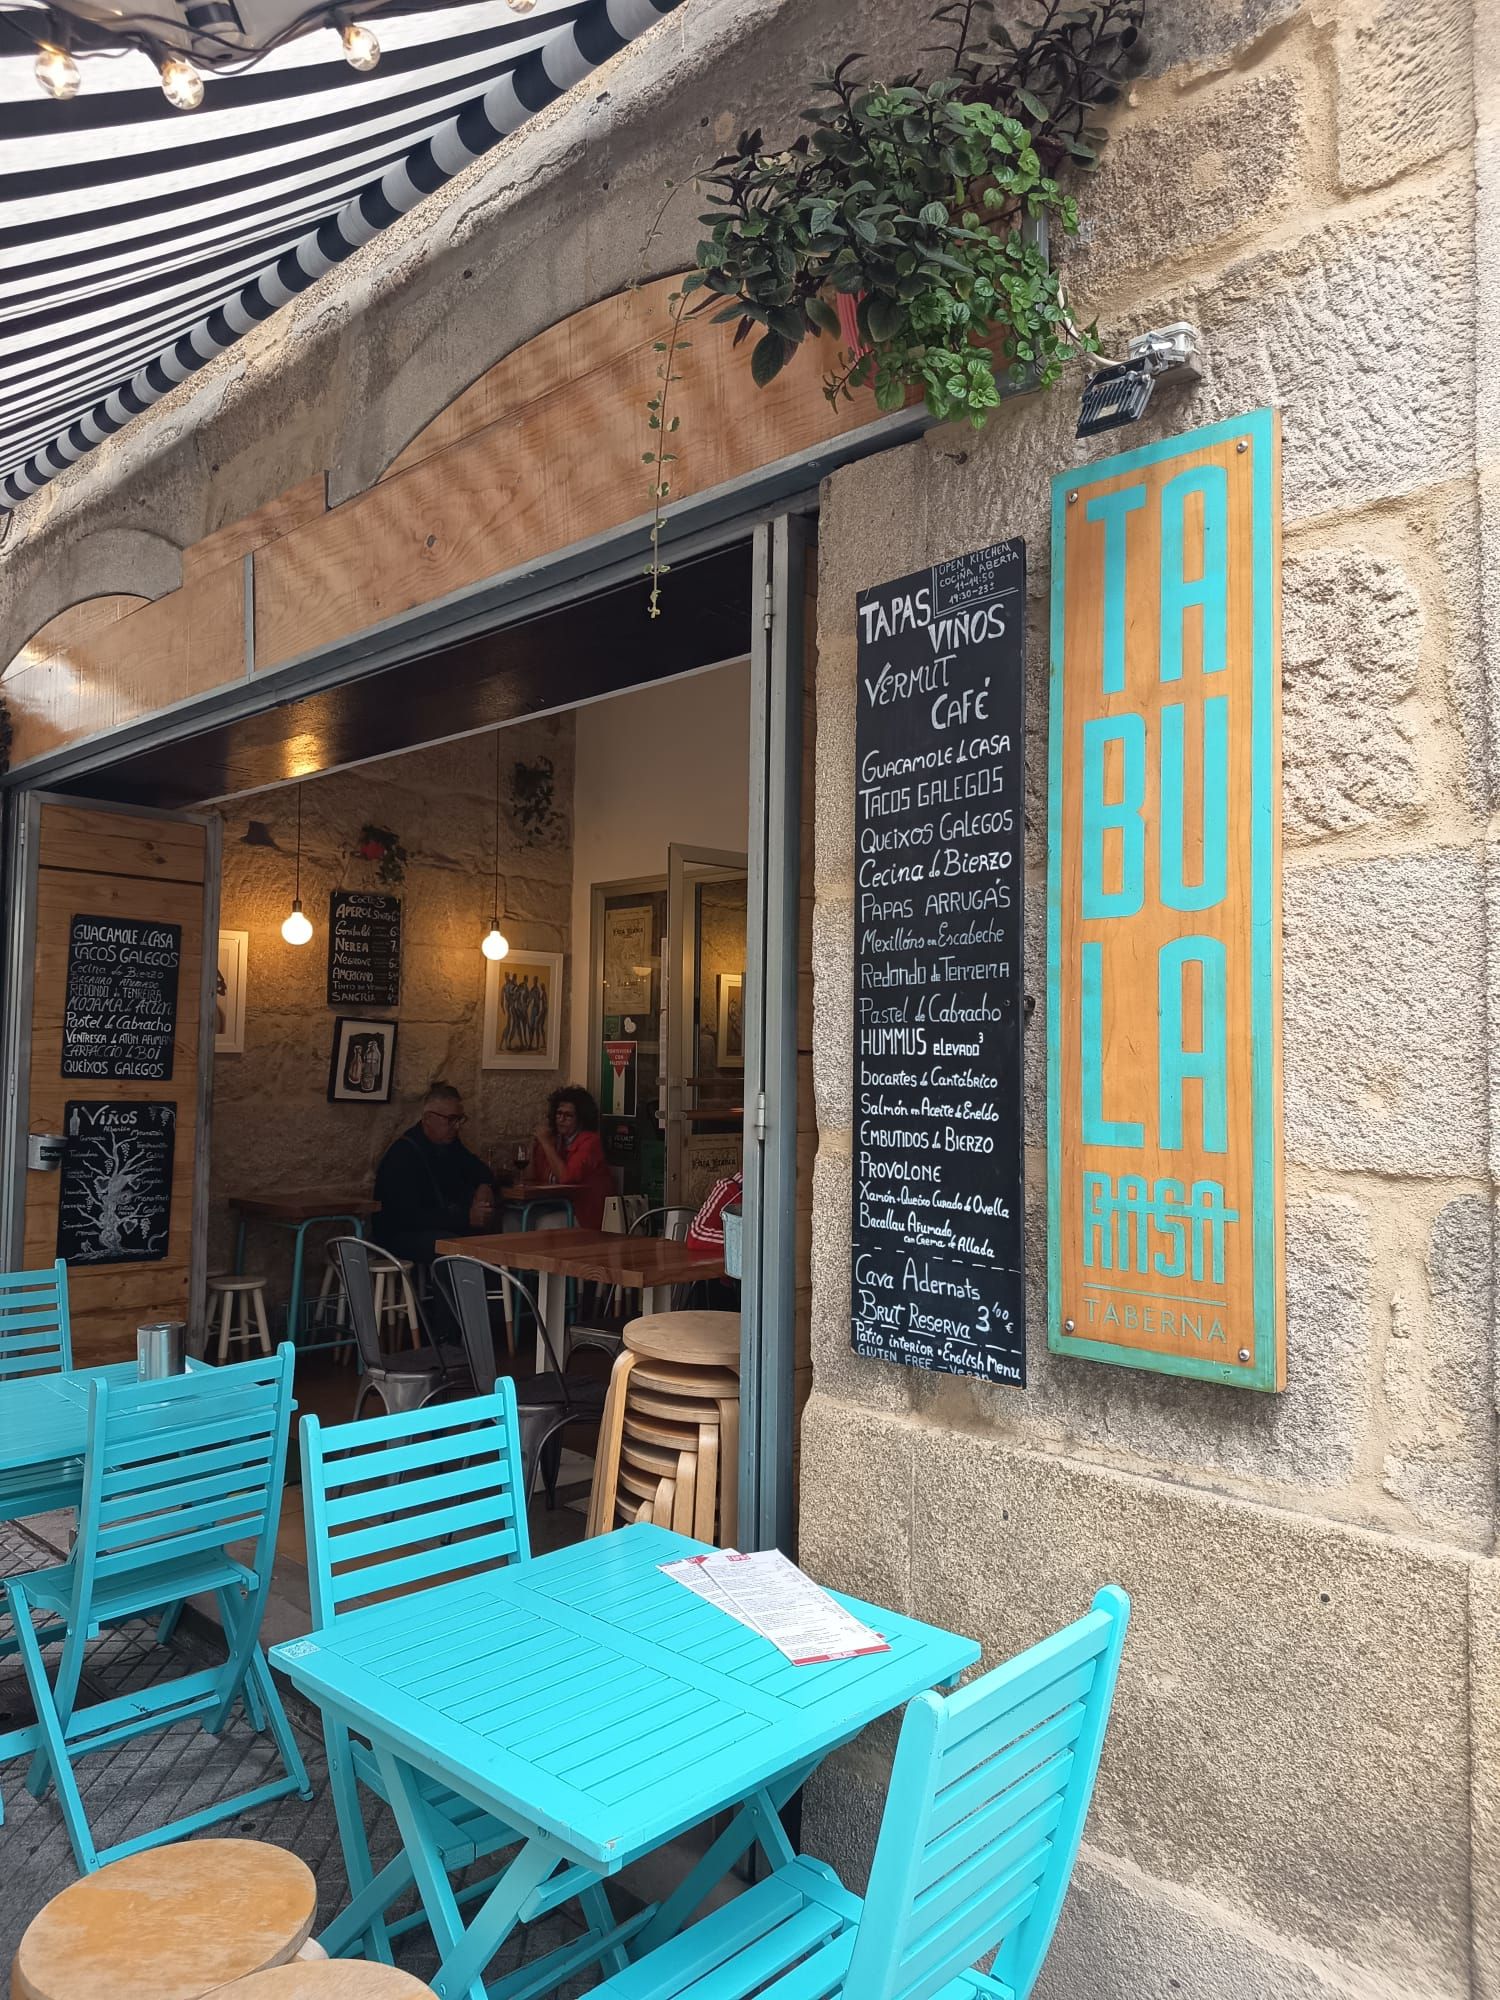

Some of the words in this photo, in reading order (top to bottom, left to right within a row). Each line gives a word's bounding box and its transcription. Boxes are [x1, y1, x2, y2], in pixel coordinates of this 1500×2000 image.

[938, 558, 964, 576] OPEN
[970, 543, 1012, 564] KITCHEN
[940, 566, 974, 588] COCIÑA
[978, 552, 1020, 574] ABERTA
[859, 588, 931, 644] TAPAS
[927, 603, 1006, 654] VIÑOS
[864, 654, 957, 708] VERMUT
[931, 676, 991, 730] CAFÉ
[969, 735, 1010, 759] CASA
[859, 786, 911, 820] TACOS
[918, 766, 1003, 807] GALEGOS
[859, 858, 925, 888] Cecina
[861, 893, 913, 923] PAPAS
[73, 924, 138, 945] GUACAMOLE
[148, 930, 173, 949] CASA
[860, 927, 925, 955] Mexillóns
[938, 917, 1005, 948] Escabeche
[72, 942, 117, 962] TACOS
[120, 947, 179, 967] GALEGOS
[861, 957, 926, 989] Redondo
[70, 984, 109, 997] REDONDO
[66, 1011, 102, 1029] Pastel
[116, 1015, 172, 1032] Cabracho
[859, 996, 909, 1024] Pastel
[915, 995, 925, 1022] de
[929, 992, 1001, 1023] Cabracho
[66, 1028, 107, 1044] VENTRESCA
[861, 1028, 927, 1055] HUMMUS
[115, 1062, 164, 1077] GALEGOS
[860, 1093, 908, 1116] Salmón
[921, 1097, 953, 1118] Aceite
[962, 1101, 999, 1122] Eneldo
[860, 1152, 942, 1182] PROVOLONE
[859, 1180, 896, 1204] Xamón
[900, 1186, 930, 1207] Queixo
[973, 1195, 1010, 1218] Ovella
[860, 1202, 905, 1231] Bacallau
[1082, 1170, 1240, 1285] RASA
[904, 1235, 915, 1243] con
[916, 1234, 946, 1248] Crema
[957, 1236, 995, 1258] Allada
[855, 1254, 894, 1289] Cava
[903, 1257, 980, 1300] Adernats
[1083, 1298, 1228, 1345] TABERNA
[856, 1321, 883, 1346] Patio
[943, 1342, 984, 1371] English
[987, 1355, 1021, 1380] Menu
[858, 1344, 897, 1362] GLUTEN
[904, 1355, 934, 1370] FREE
